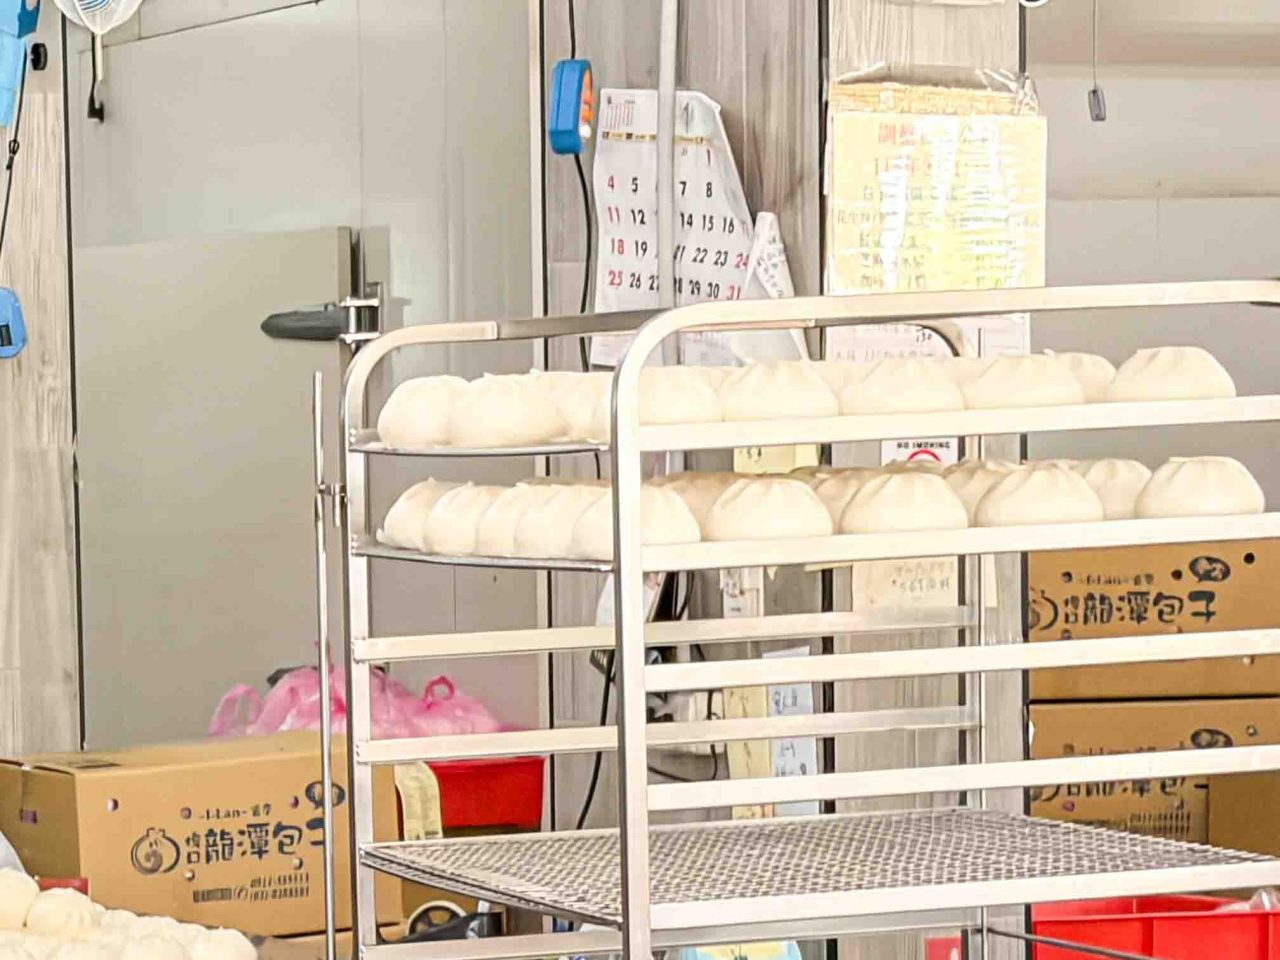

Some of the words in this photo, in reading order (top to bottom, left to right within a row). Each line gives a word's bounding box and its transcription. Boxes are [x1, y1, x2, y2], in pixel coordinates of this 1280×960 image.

[607, 175, 615, 191] 4
[631, 177, 638, 193] 5
[679, 181, 687, 197] 7
[706, 181, 713, 198] 8
[607, 206, 620, 223] 11
[631, 208, 646, 225] 12
[680, 212, 693, 230] 14
[702, 214, 714, 231] 15
[722, 217, 735, 234] 16
[610, 239, 624, 255] 18
[635, 240, 648, 258] 19
[692, 247, 708, 264] 22
[713, 250, 729, 268] 23
[734, 253, 749, 269] 24
[608, 270, 623, 287] 25
[629, 272, 642, 289] 26
[689, 279, 701, 296] 29
[706, 282, 720, 299] 30
[727, 285, 741, 300] 31
